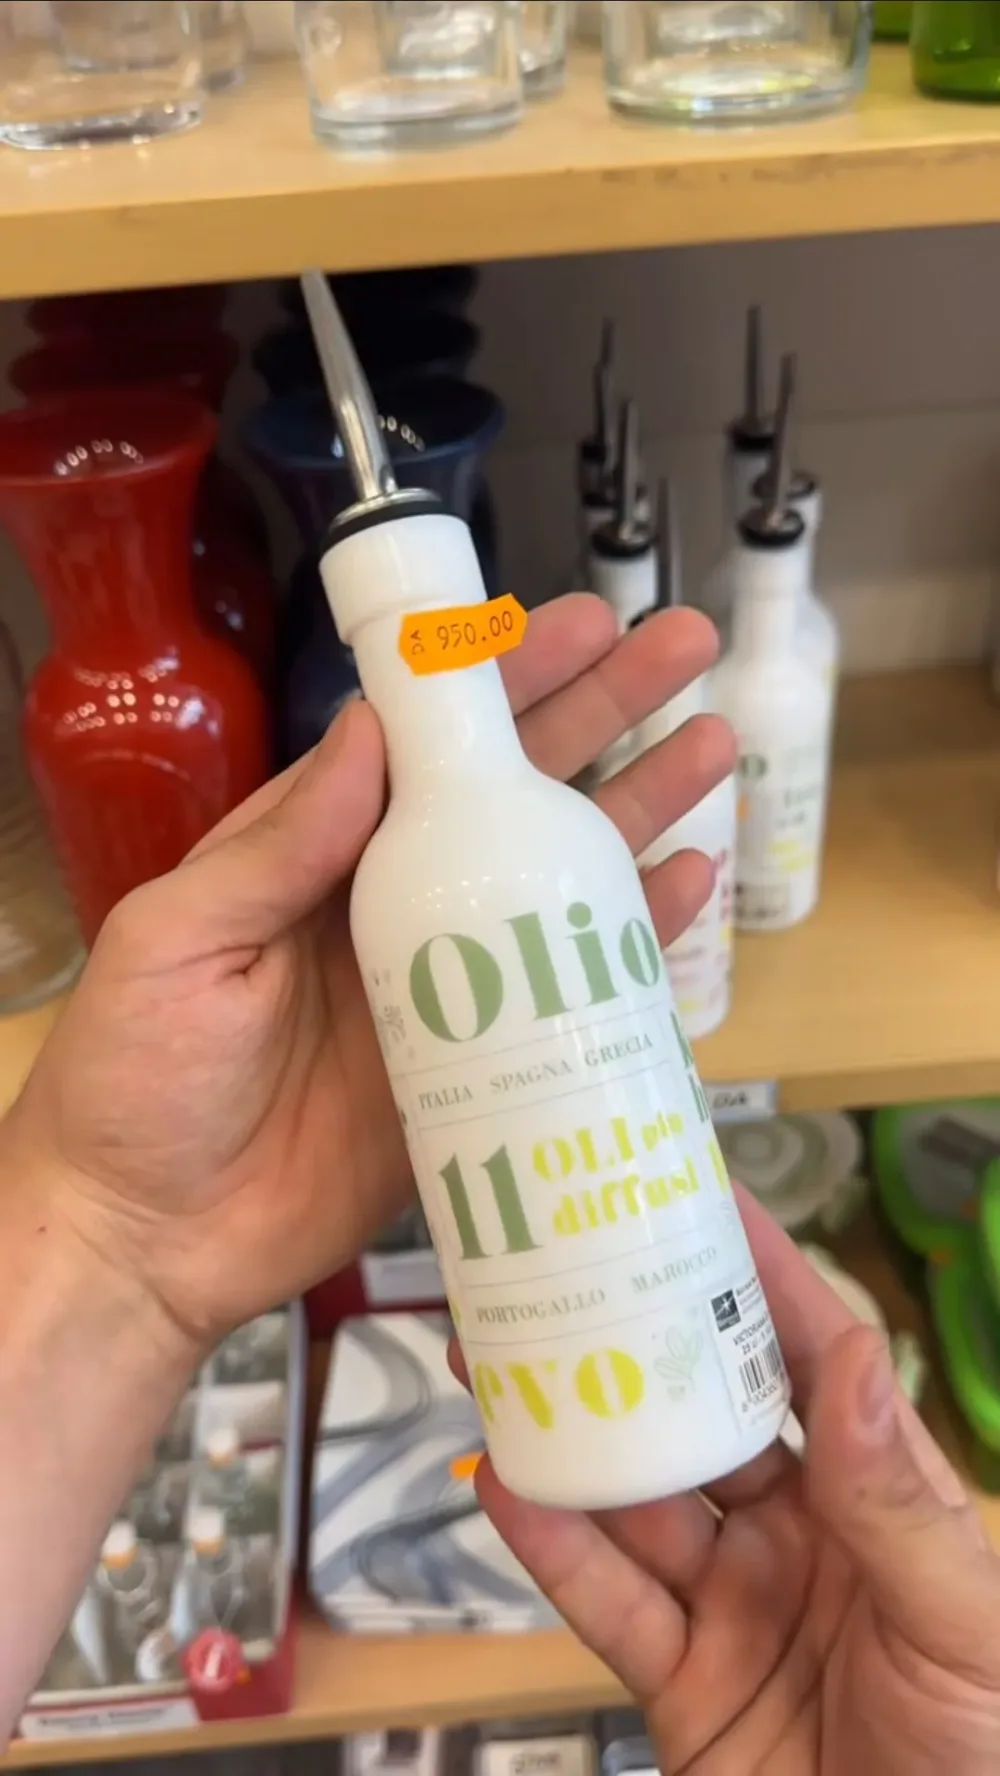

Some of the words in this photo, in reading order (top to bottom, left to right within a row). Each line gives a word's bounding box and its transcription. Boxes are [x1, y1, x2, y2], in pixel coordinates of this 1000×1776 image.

[436, 610, 514, 650] 950.00
[409, 901, 660, 1043] Olio
[418, 1085, 474, 1110] ITALIA
[489, 1058, 573, 1091] SPAGNA
[584, 1033, 653, 1068] GRECIA
[531, 1116, 635, 1183] OLI
[552, 1154, 700, 1237] diffusi
[476, 1288, 606, 1324] PORTOGALLO
[631, 1246, 718, 1293] MAROCCO
